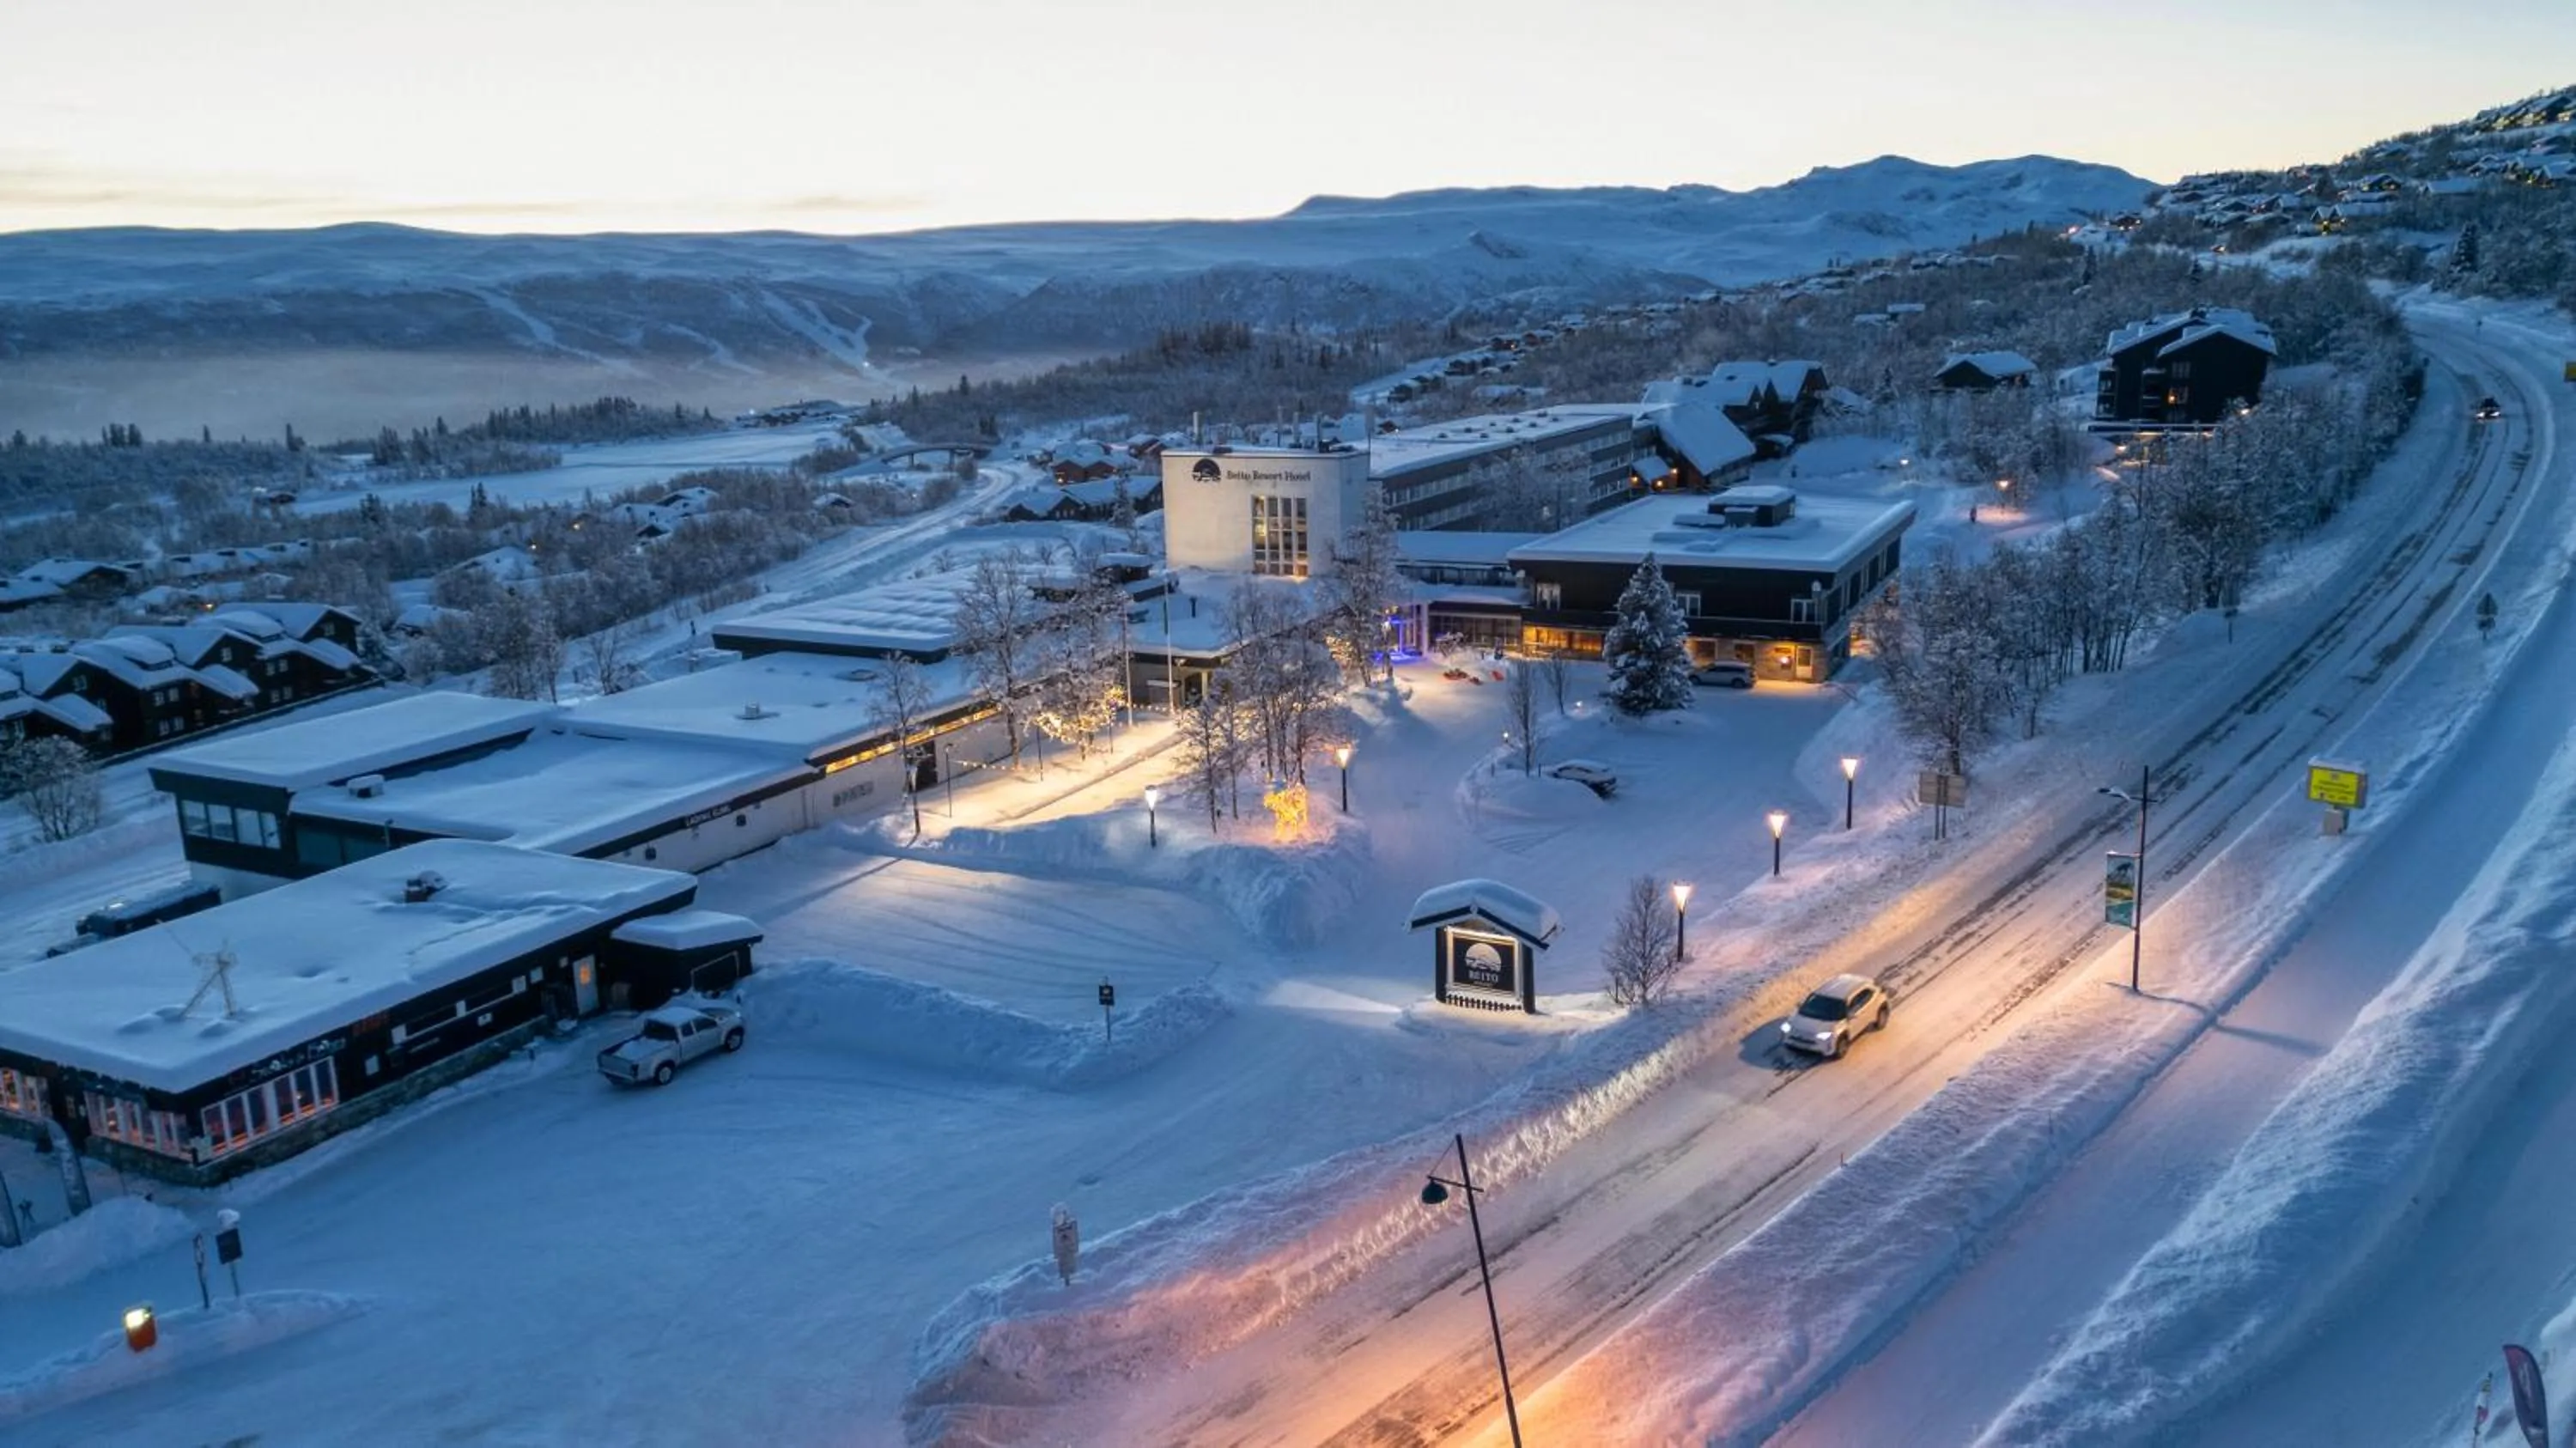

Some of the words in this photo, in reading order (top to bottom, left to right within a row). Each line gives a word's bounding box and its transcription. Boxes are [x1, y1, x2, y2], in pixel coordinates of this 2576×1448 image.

[1253, 470, 1282, 481] Resort
[1285, 470, 1311, 482] Hotel
[1468, 970, 1498, 983] BEITO
